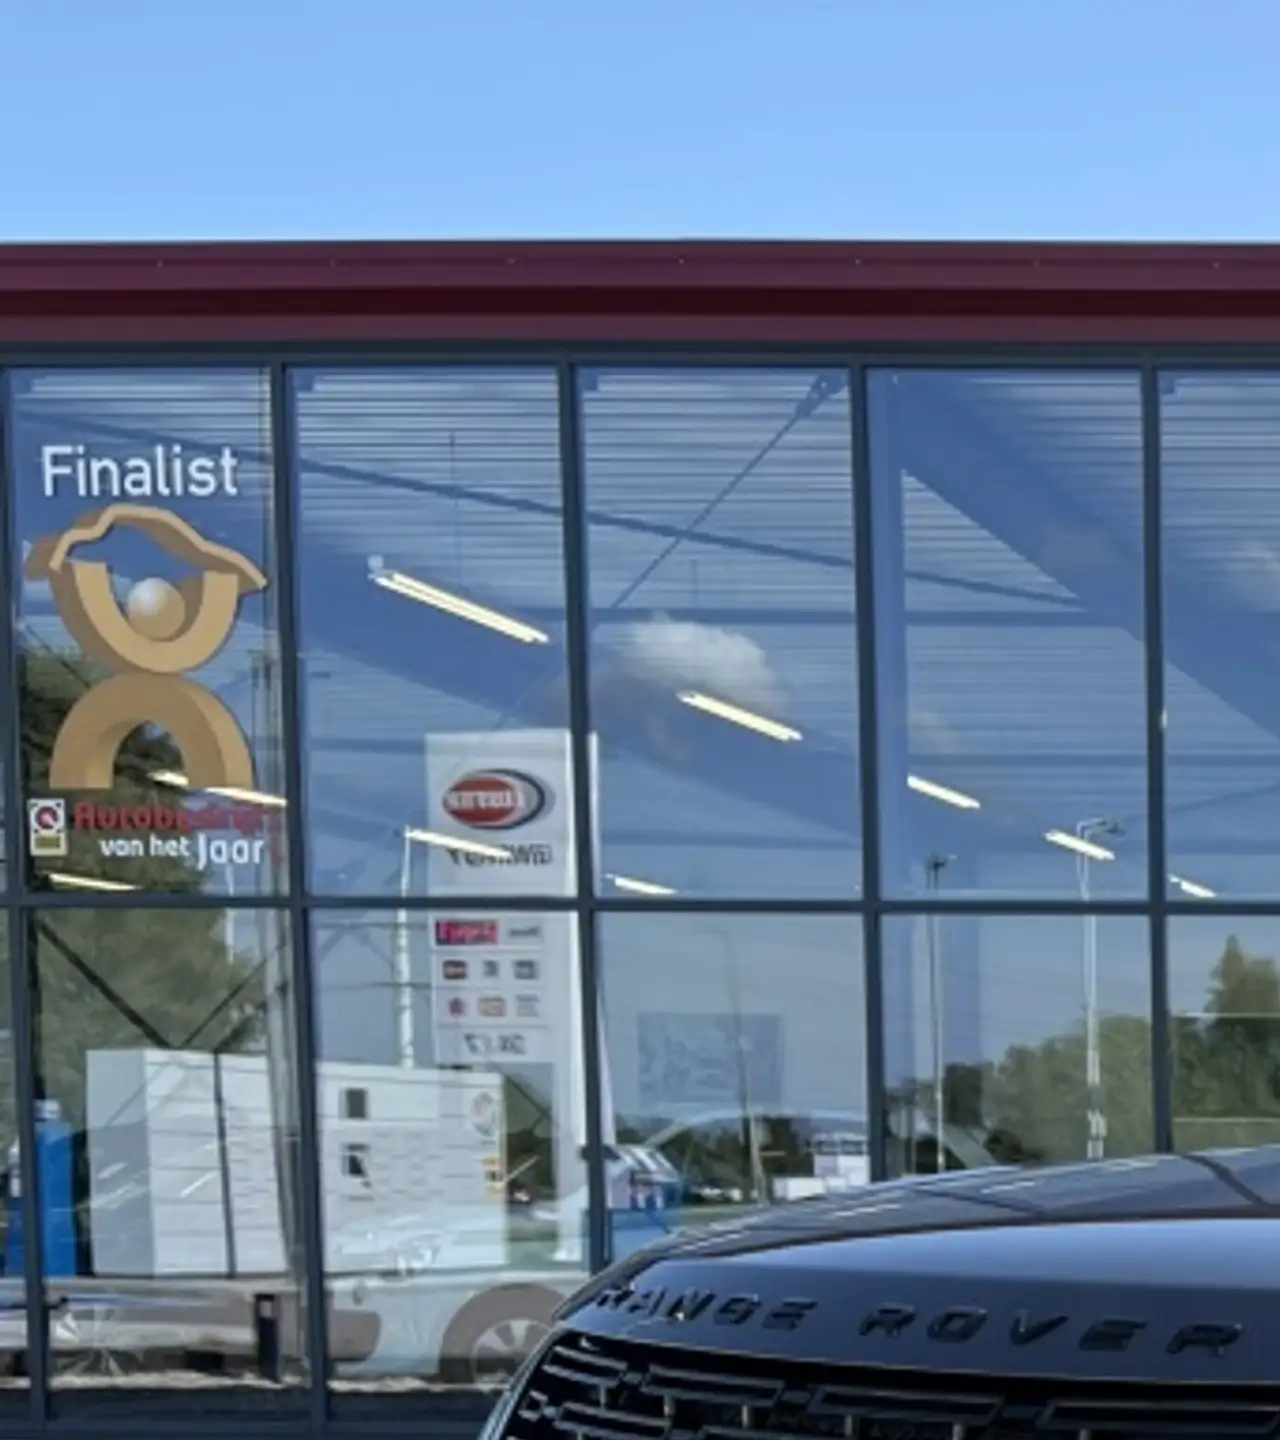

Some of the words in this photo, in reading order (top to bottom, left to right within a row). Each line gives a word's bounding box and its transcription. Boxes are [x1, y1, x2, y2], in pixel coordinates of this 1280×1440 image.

[42, 444, 237, 497] Finalist
[74, 802, 264, 834] Autobe
[99, 838, 144, 857] van
[150, 832, 190, 857] het
[858, 1304, 1244, 1358] ROVER
